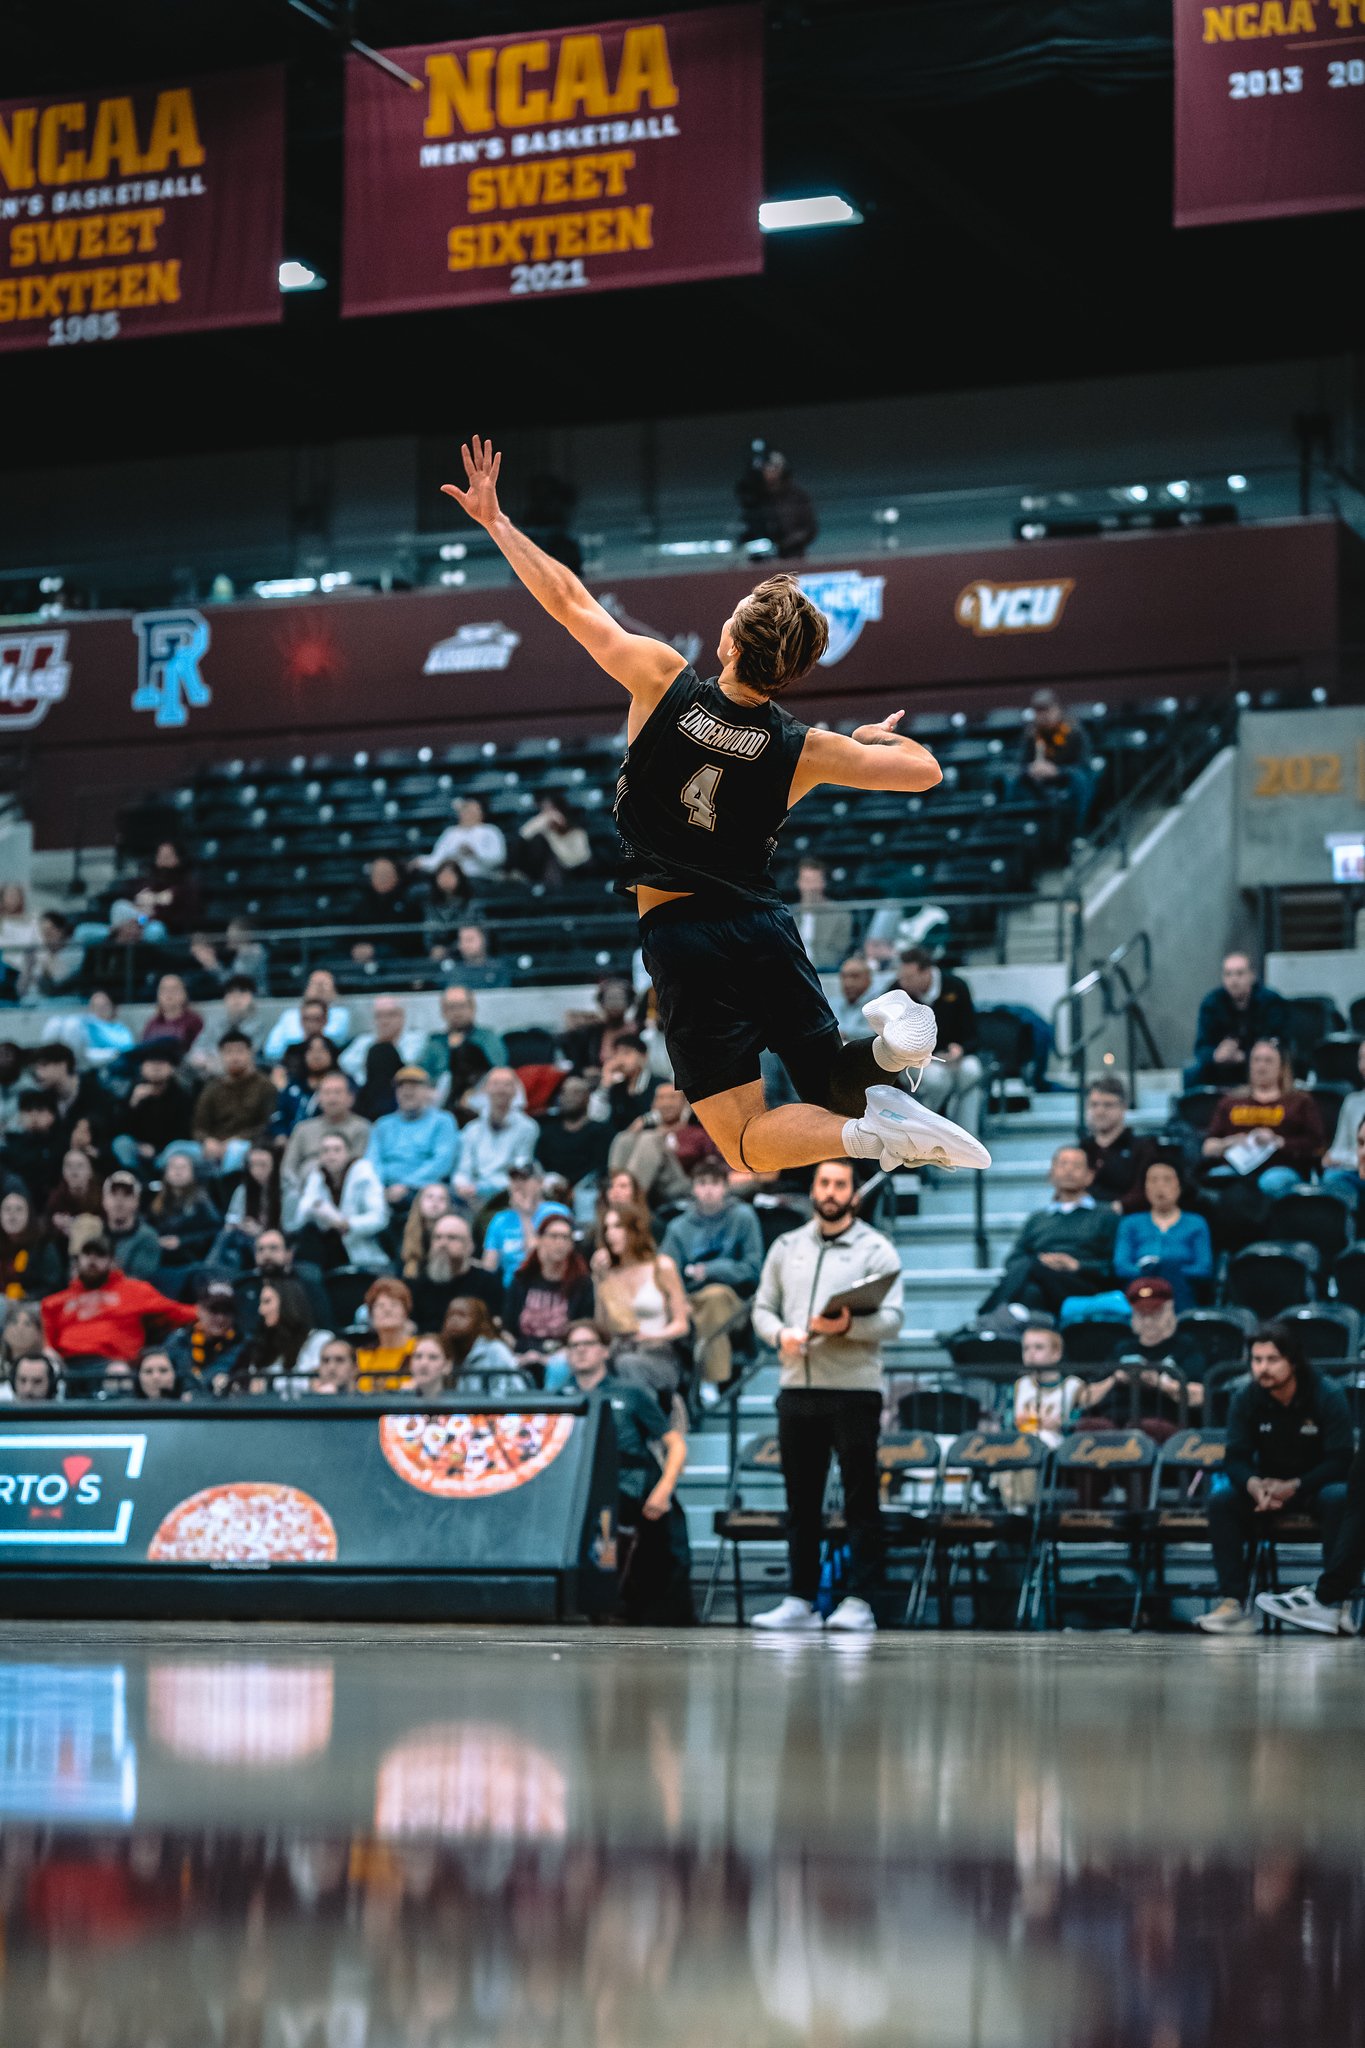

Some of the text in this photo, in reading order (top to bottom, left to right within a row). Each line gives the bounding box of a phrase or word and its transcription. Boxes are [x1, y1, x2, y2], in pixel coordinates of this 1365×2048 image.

[1202, 0, 1317, 43] NCAA
[424, 24, 679, 138] NCAA
[1228, 65, 1304, 99] 2013
[419, 114, 680, 168] MEN'S BASKETBALL
[52, 174, 206, 214] BASKETBALL
[467, 150, 635, 213] SWEET
[10, 207, 164, 268] SWEET
[447, 203, 653, 271] SIXTEEN
[510, 259, 588, 294] 2021
[48, 310, 120, 346] 1985
[977, 582, 1064, 629] VCU
[678, 705, 769, 758] LINDENWOOD
[681, 763, 723, 832] 4
[1254, 754, 1341, 796] 202
